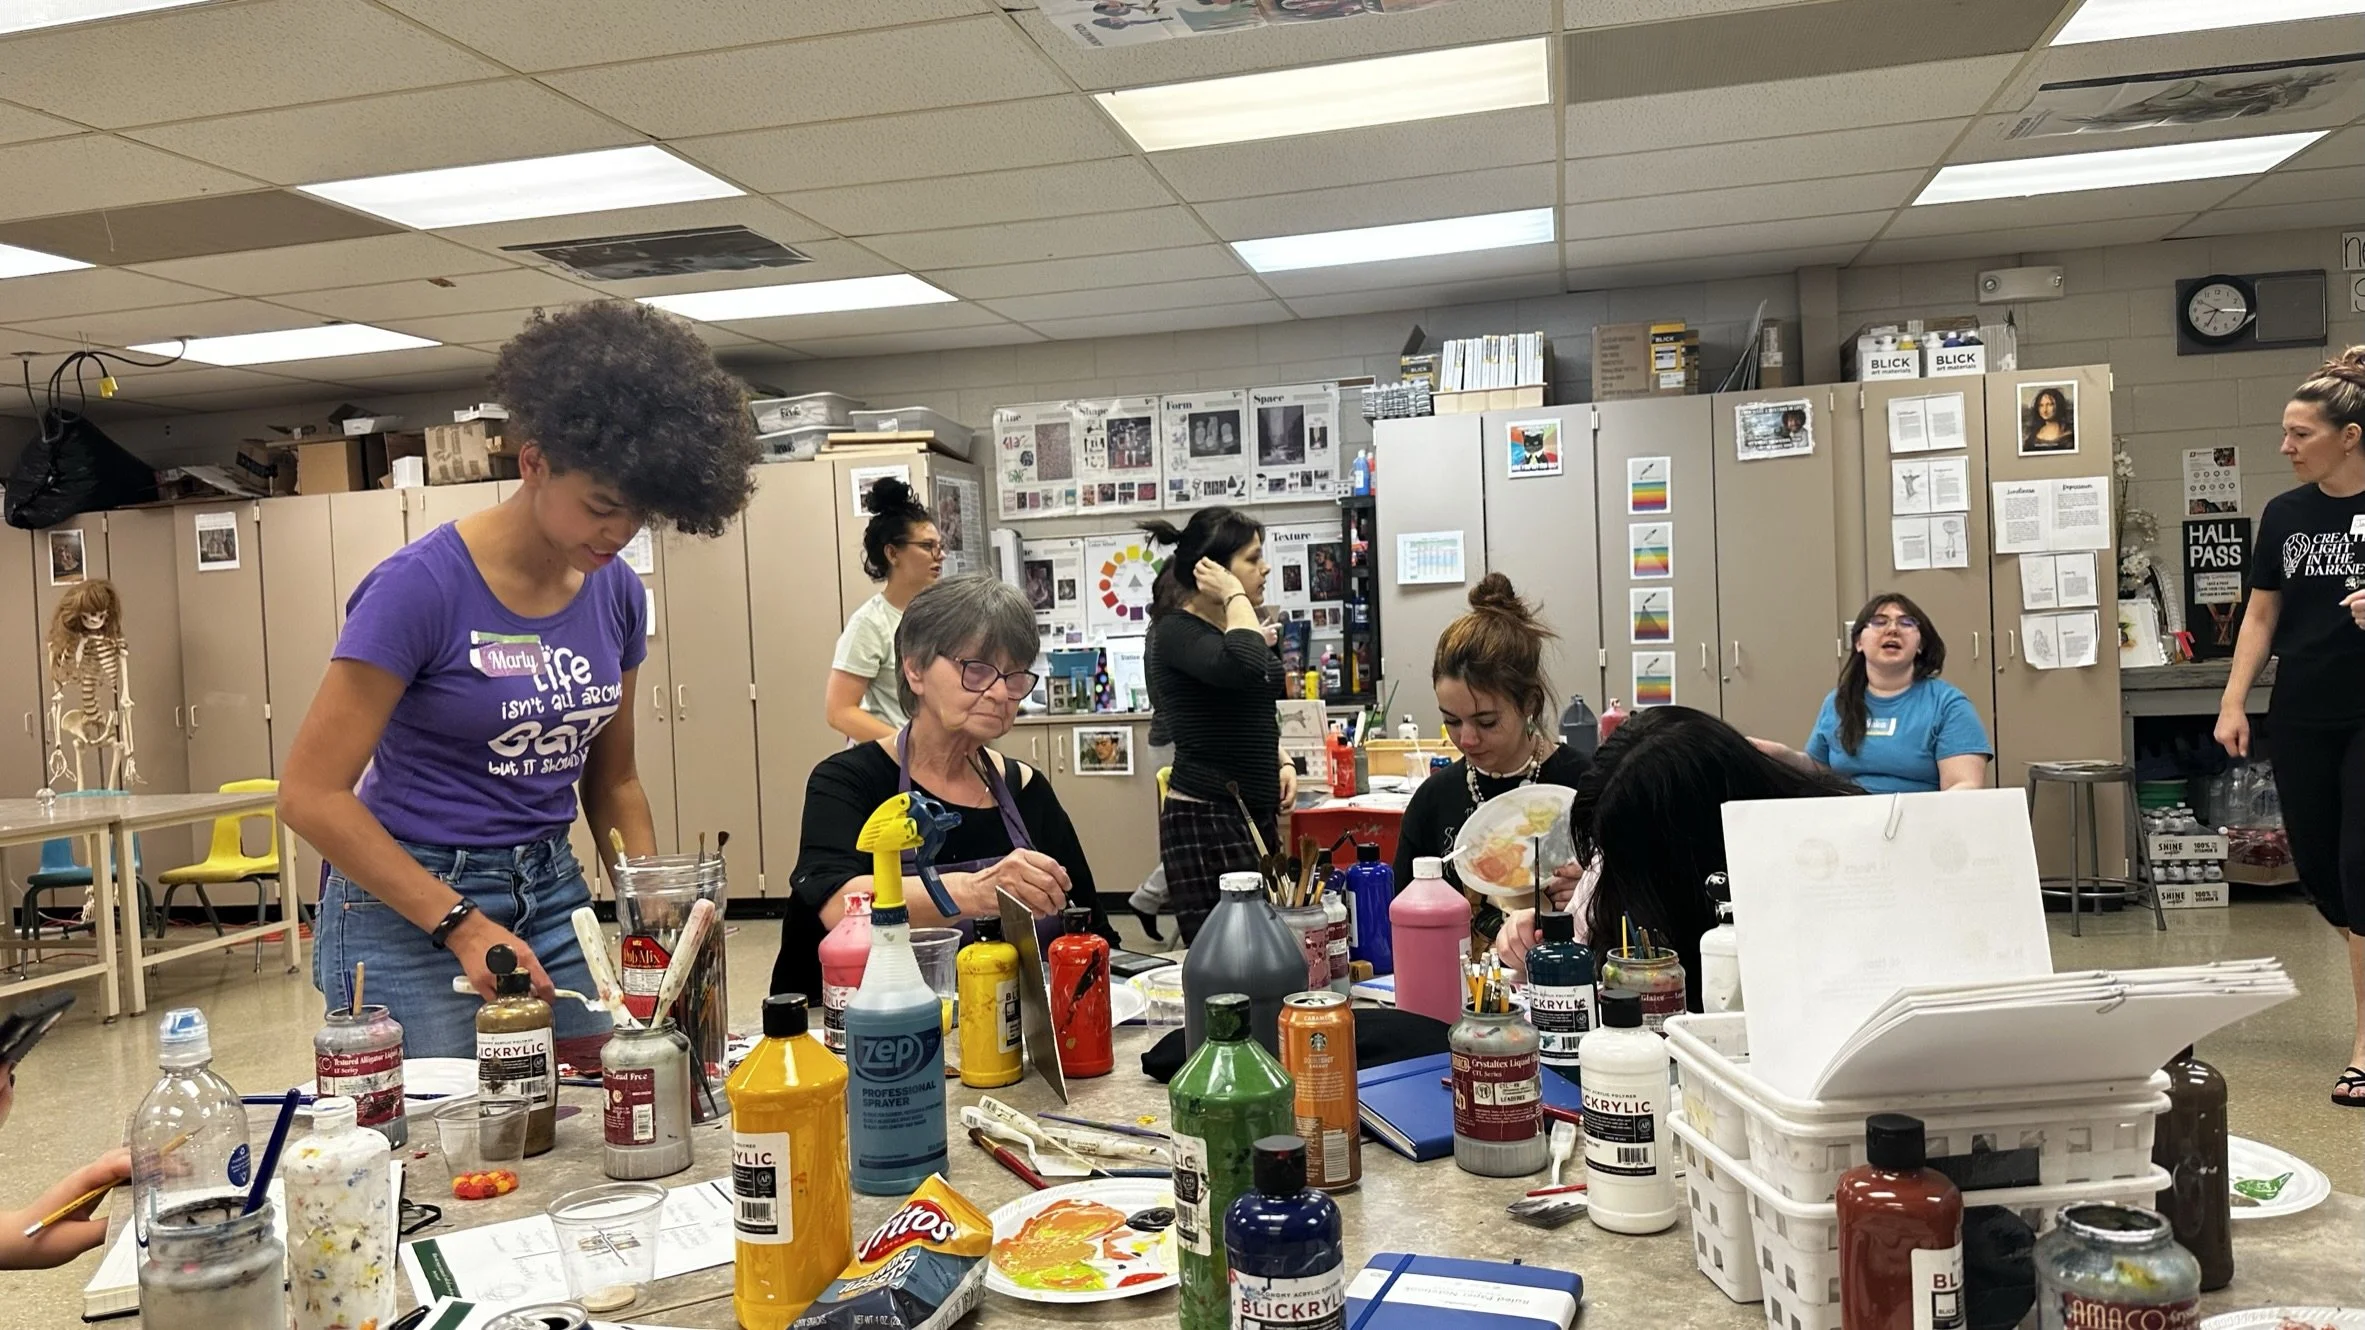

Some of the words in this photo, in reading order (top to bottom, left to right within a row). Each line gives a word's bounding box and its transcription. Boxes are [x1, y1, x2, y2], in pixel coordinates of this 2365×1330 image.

[1871, 358, 1911, 369] BLICK
[1936, 353, 1976, 366] BLICK
[1947, 363, 1977, 371] materials
[1253, 394, 1285, 405] Space
[1166, 401, 1193, 411] Form
[1272, 532, 1311, 542] Texture
[2189, 523, 2243, 544] HALL
[2310, 542, 2354, 554] LIGHT
[2189, 545, 2242, 568] PASS
[2306, 554, 2322, 565] IN
[2325, 552, 2355, 565] THE
[488, 650, 538, 674] Marly
[502, 696, 545, 720] isn't
[2158, 842, 2183, 851] SHINE
[2161, 891, 2185, 900] SHINE
[334, 1056, 359, 1066] Textured
[360, 1054, 384, 1065] Alligator
[1471, 1058, 1509, 1070] Crystaltex
[1509, 1055, 1531, 1069] Liquid
[630, 1073, 648, 1081] Free
[862, 1080, 937, 1098] PROFESSIONAL
[862, 1096, 910, 1109] SPRAYER
[1293, 1289, 1321, 1298] ACRYLIC
[1241, 1287, 1345, 1319] BLICKRYLI
[2071, 1299, 2166, 1330] AMACO
